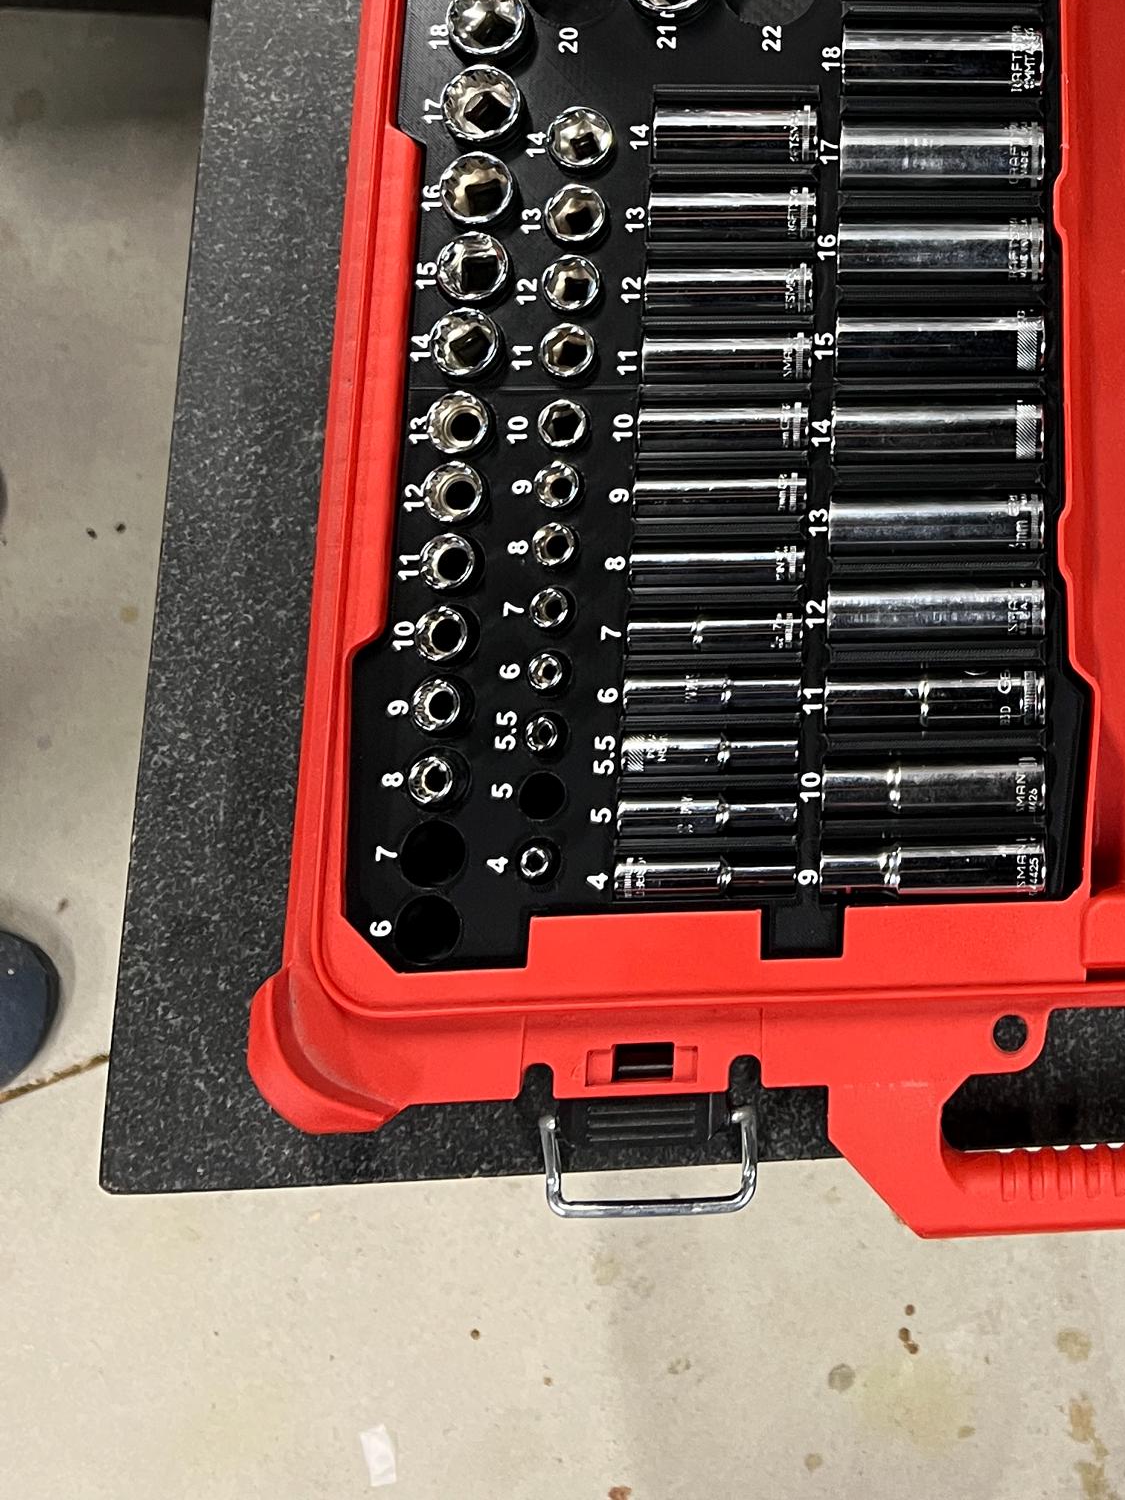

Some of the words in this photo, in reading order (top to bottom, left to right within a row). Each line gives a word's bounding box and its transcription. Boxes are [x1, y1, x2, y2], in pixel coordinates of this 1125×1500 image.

[428, 23, 450, 50] 18
[558, 26, 578, 54] 20
[656, 25, 677, 49] 21
[762, 25, 782, 52] 22
[821, 46, 842, 71] 18
[422, 98, 442, 124] 17
[526, 130, 546, 158] 14
[629, 124, 650, 150] 14
[820, 139, 838, 165] 17
[421, 185, 442, 212] 16
[521, 207, 542, 235] 13
[625, 206, 645, 233] 13
[817, 233, 837, 261] 16
[415, 261, 437, 290] 15
[516, 278, 538, 306] 12
[621, 276, 642, 304] 12
[410, 333, 431, 362] 14
[511, 345, 534, 371] 11
[814, 332, 834, 360] 15
[617, 350, 638, 376] 11
[408, 416, 429, 445] 13
[506, 415, 529, 444] 10
[612, 413, 634, 442] 10
[811, 419, 831, 447] 14
[403, 484, 425, 512] 12
[511, 479, 533, 495] 9
[608, 488, 630, 503] 9
[809, 508, 829, 537] 13
[507, 540, 529, 555] 8
[397, 554, 420, 582] 11
[605, 555, 626, 571] 8
[503, 601, 524, 618] 7
[806, 599, 827, 629] 12
[392, 620, 416, 651] 10
[600, 625, 622, 641] 7
[499, 662, 521, 680] 6
[387, 699, 409, 717] 9
[597, 687, 619, 704] 6
[802, 687, 824, 715] 11
[494, 710, 518, 751] 5.5
[593, 735, 616, 776] 5.5
[381, 771, 404, 788] 8
[491, 782, 513, 800] 5
[800, 771, 821, 803] 10
[590, 806, 612, 824] 5
[375, 845, 398, 862] 7
[486, 856, 508, 874] 4
[586, 872, 609, 890] 4
[797, 868, 820, 887] 9
[369, 919, 392, 937] 6
